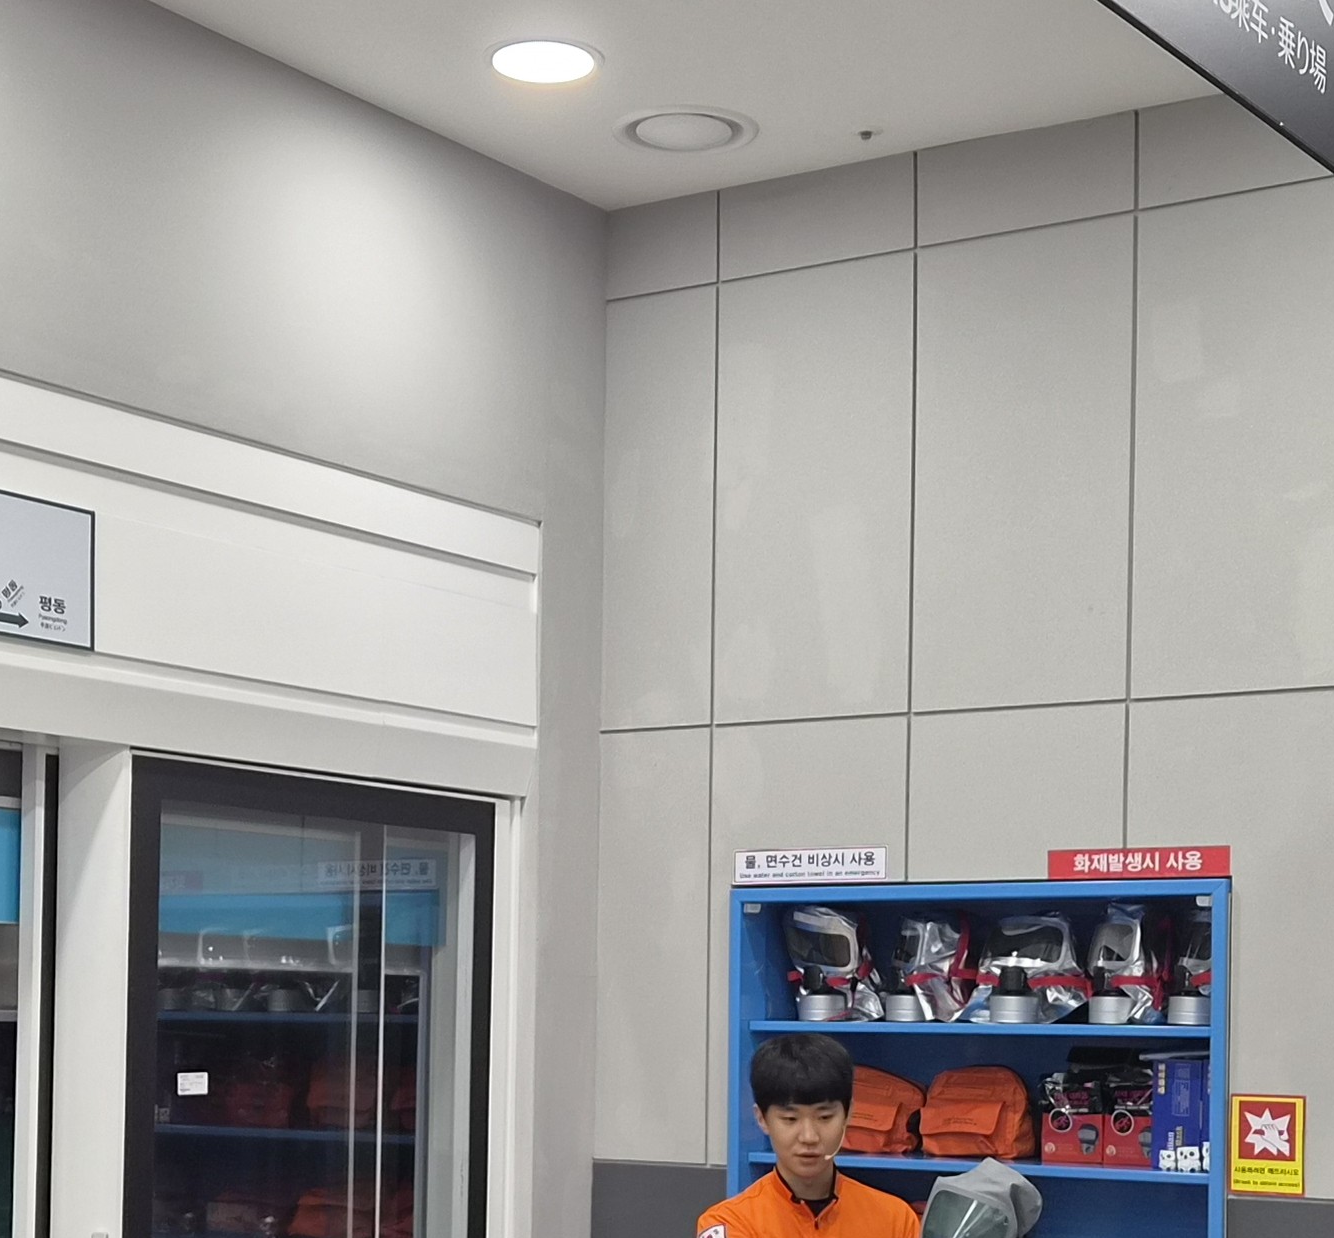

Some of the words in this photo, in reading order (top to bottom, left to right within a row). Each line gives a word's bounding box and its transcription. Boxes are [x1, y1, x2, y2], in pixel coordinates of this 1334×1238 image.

[39, 595, 66, 615] 평동
[745, 855, 760, 870] 물,
[767, 854, 802, 869] 면수건
[808, 852, 845, 868] 비상시
[850, 851, 875, 867] 사용
[1073, 851, 1160, 873] 화재발생시
[1165, 850, 1203, 872] 사용
[844, 869, 880, 877] emergency
